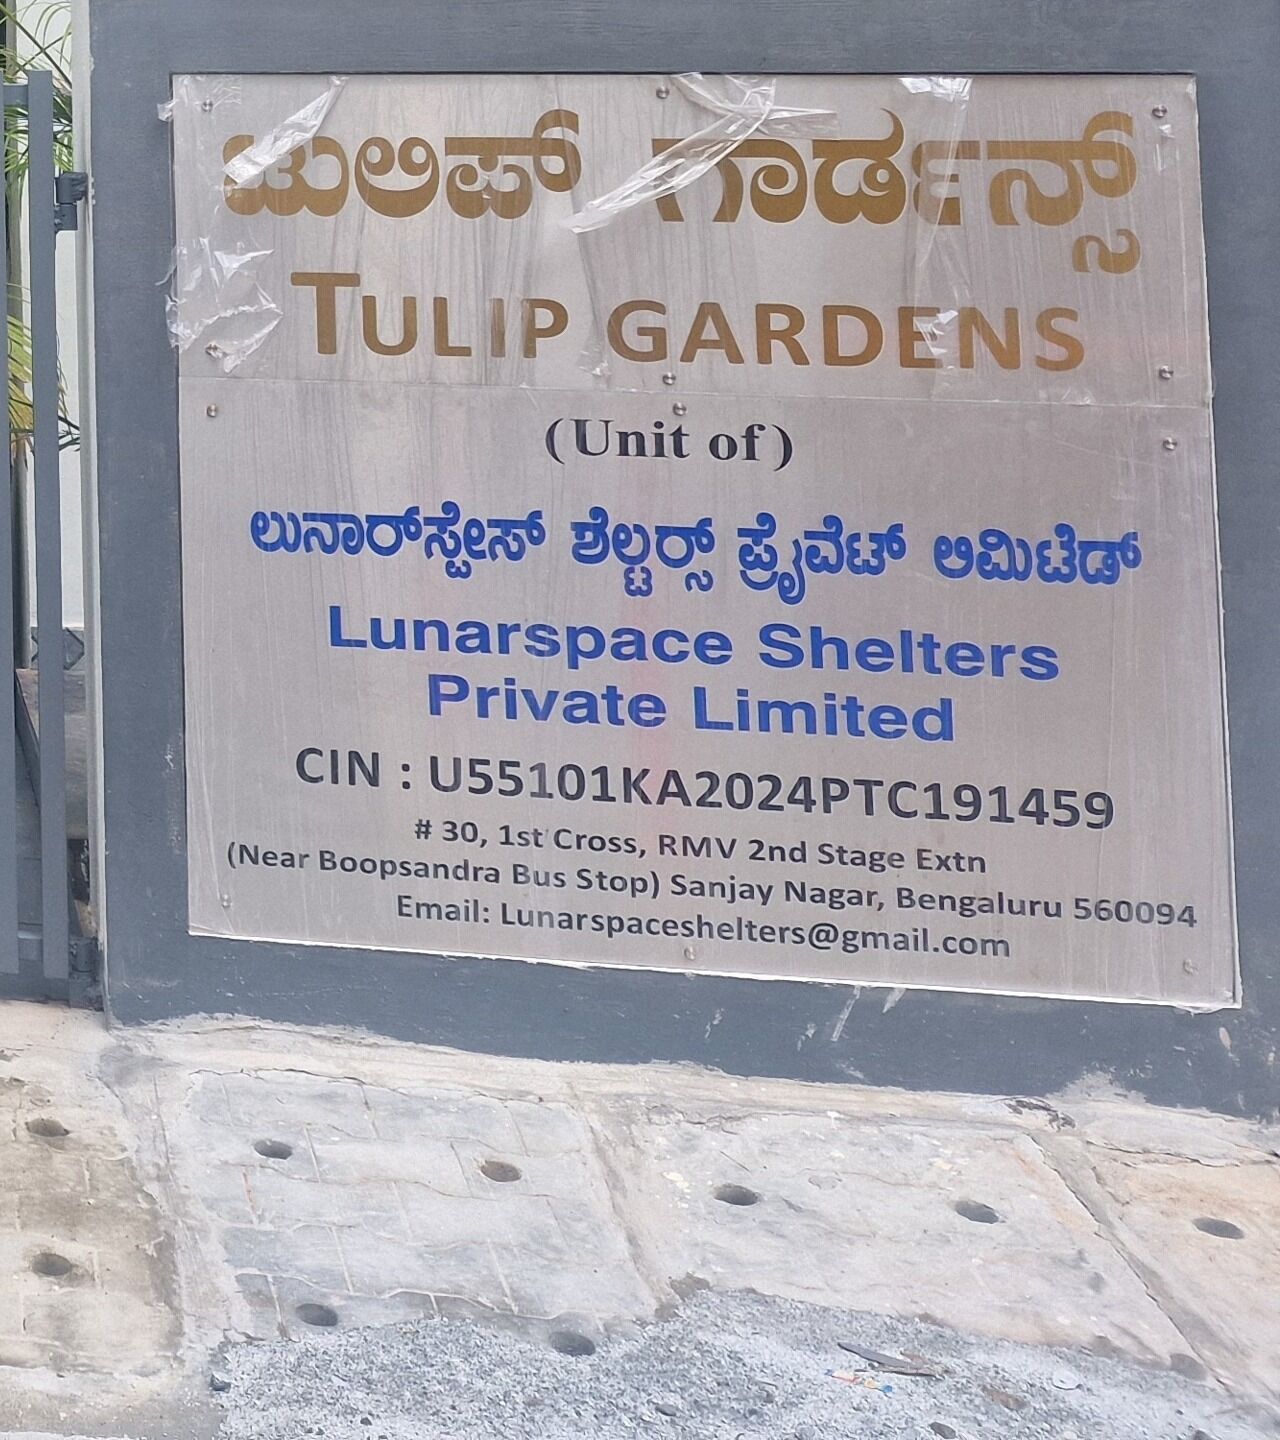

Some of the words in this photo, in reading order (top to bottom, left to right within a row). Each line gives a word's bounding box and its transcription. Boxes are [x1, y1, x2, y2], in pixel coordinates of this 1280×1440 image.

[291, 271, 570, 358] TULIP
[608, 301, 1087, 374] GARDENS
[543, 416, 692, 466] (Unit
[707, 422, 794, 473] of)
[328, 605, 734, 672] Lunarspace
[758, 622, 1061, 683] Shelters
[427, 673, 668, 729] Private
[692, 686, 956, 743] Limited
[294, 746, 381, 789] CIN
[428, 754, 1115, 831] U55101KA2024PTC191459
[441, 819, 489, 850] 30,
[497, 823, 545, 850] 1st
[552, 827, 648, 860] Cross,
[657, 833, 739, 860] RMV
[747, 837, 808, 865] 2nd
[816, 841, 906, 875] Stage
[915, 847, 987, 875] Extn
[226, 840, 312, 871] (Near
[317, 848, 502, 885] Boopsandra
[511, 862, 568, 889] Bus
[575, 867, 661, 901] Stop)
[669, 872, 775, 907] Sanjay
[783, 879, 886, 913] Nagar,
[895, 886, 1063, 920] Bengaluru
[1072, 896, 1199, 929] 560094
[396, 893, 491, 925] Email:
[499, 901, 1011, 959] Lunarspaceshelters@gmail.com
